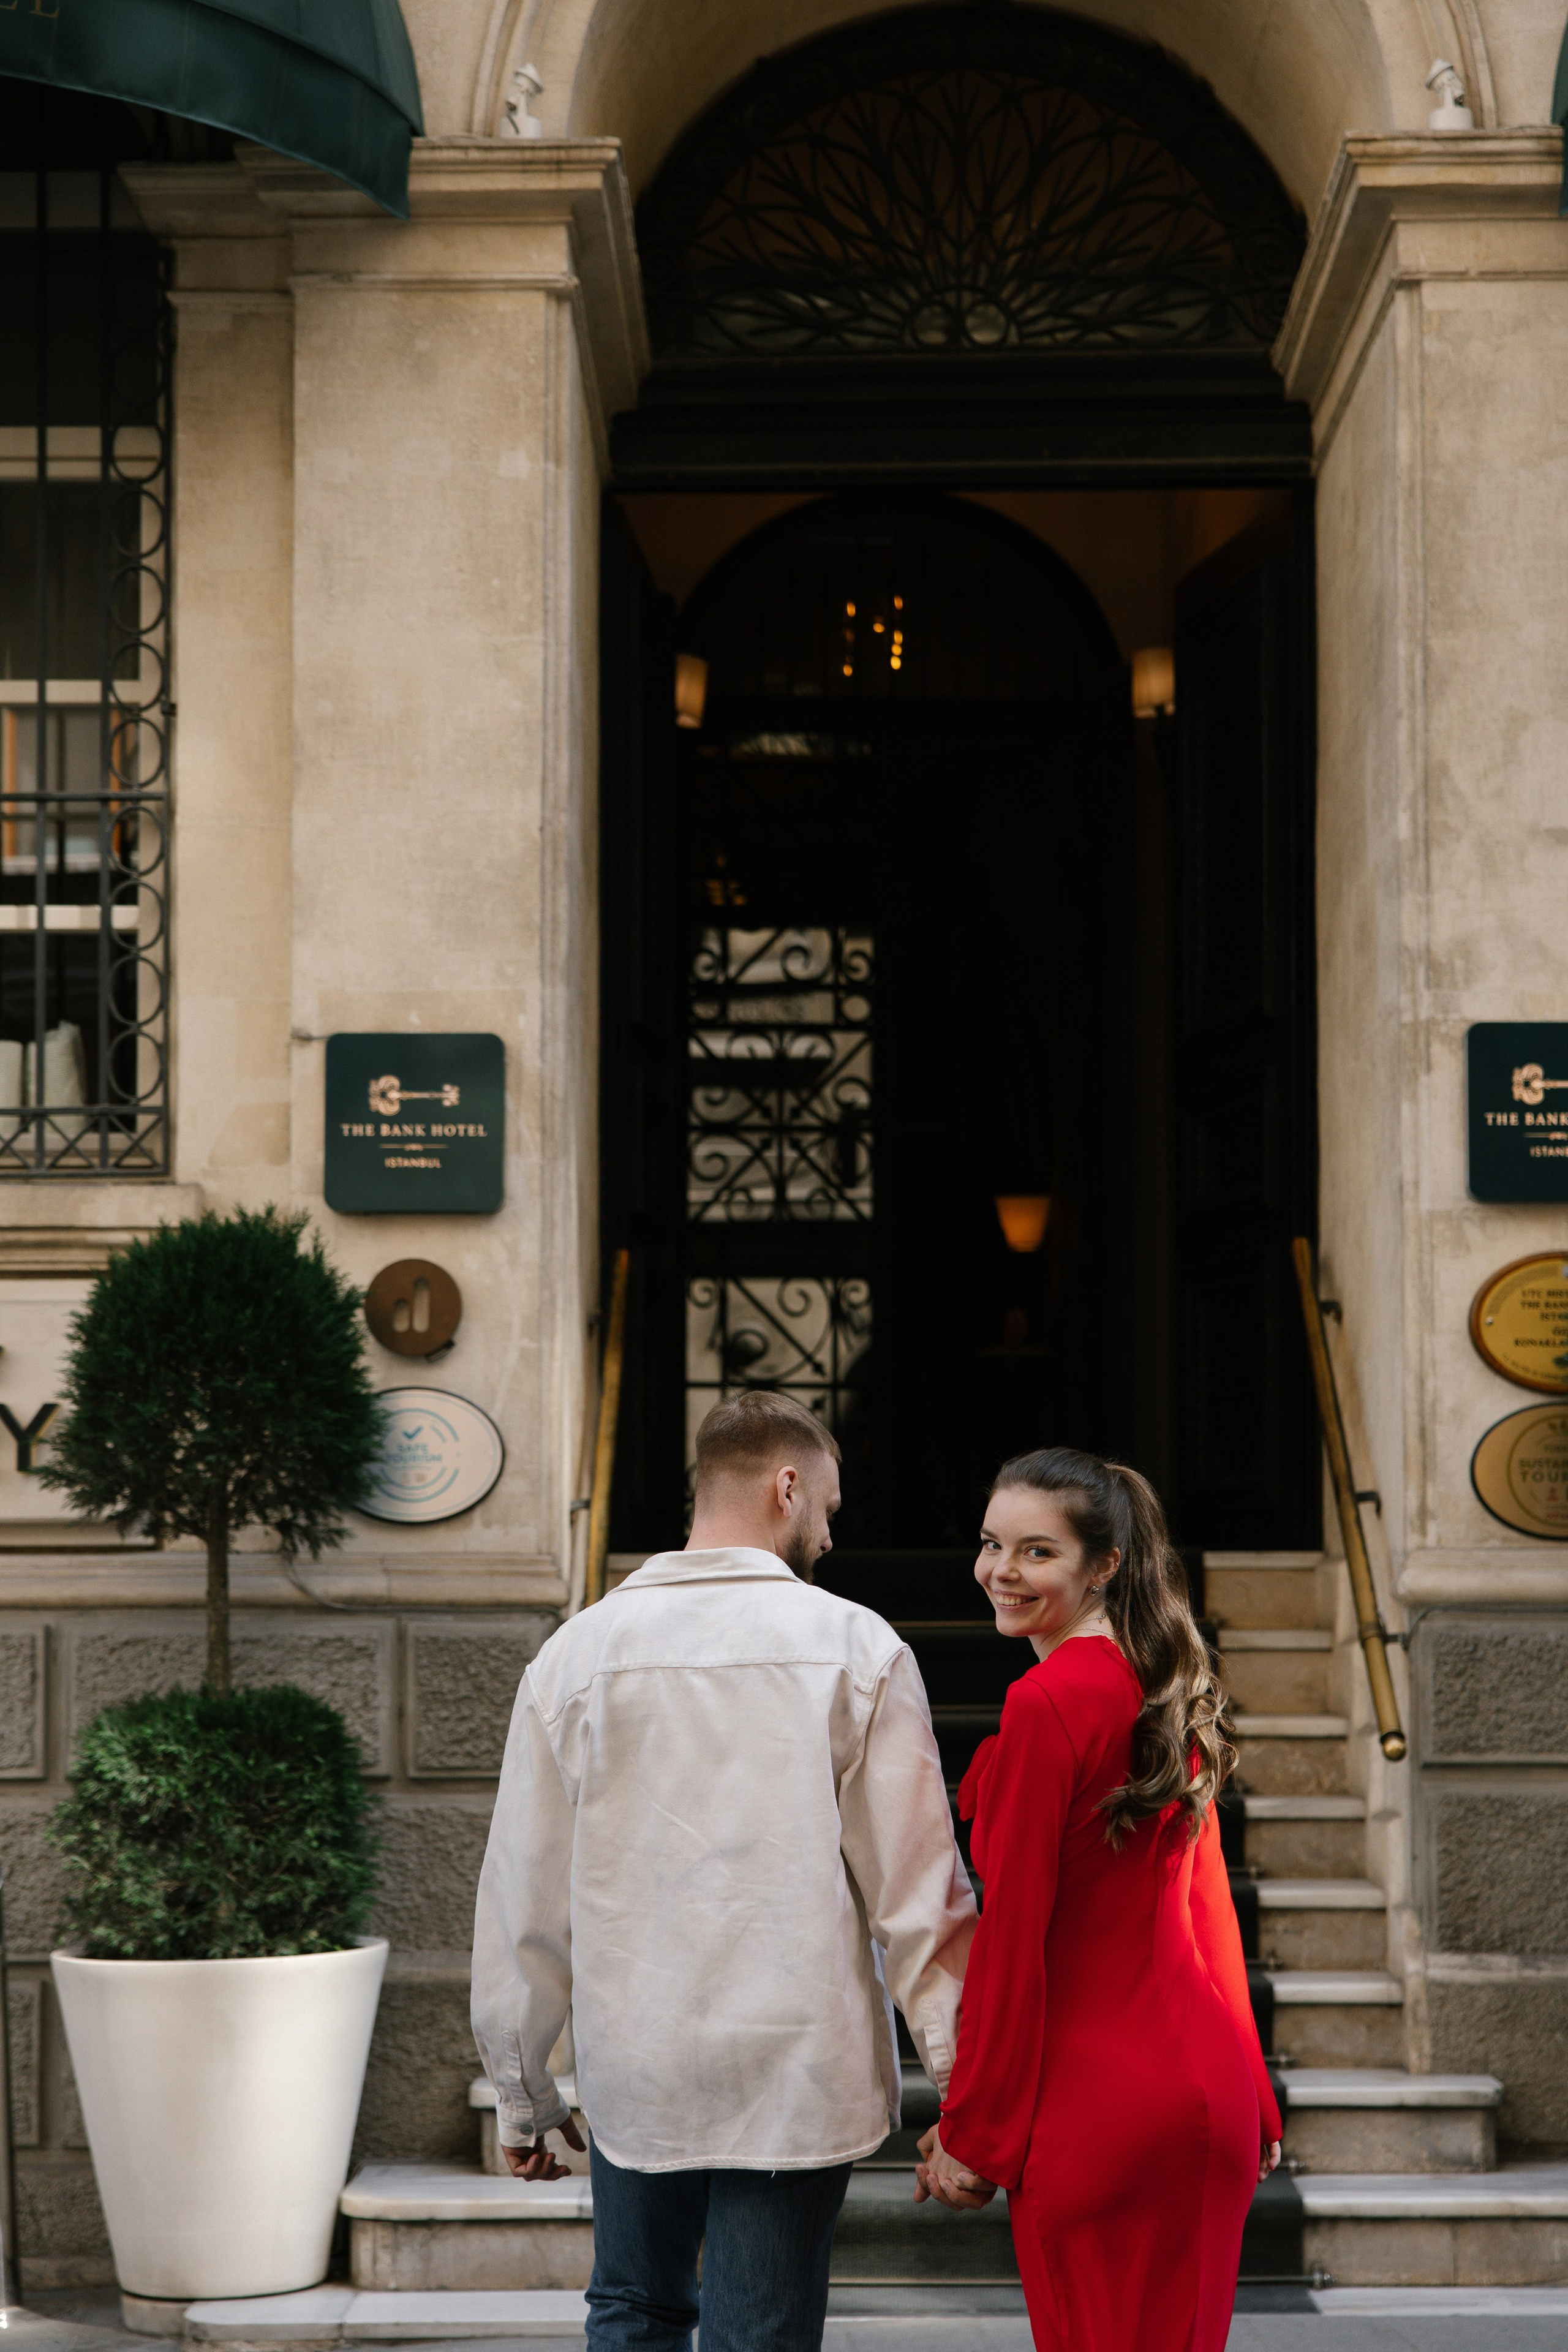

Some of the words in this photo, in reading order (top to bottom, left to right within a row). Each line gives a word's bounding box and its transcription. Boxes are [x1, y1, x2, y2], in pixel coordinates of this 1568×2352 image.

[1484, 1112, 1519, 1126] THE
[1525, 1112, 1568, 1126] BANK
[340, 1123, 375, 1137] THE
[380, 1123, 426, 1137] BANK
[431, 1123, 488, 1137] HOTEL
[384, 1156, 442, 1169] ISTANBUL
